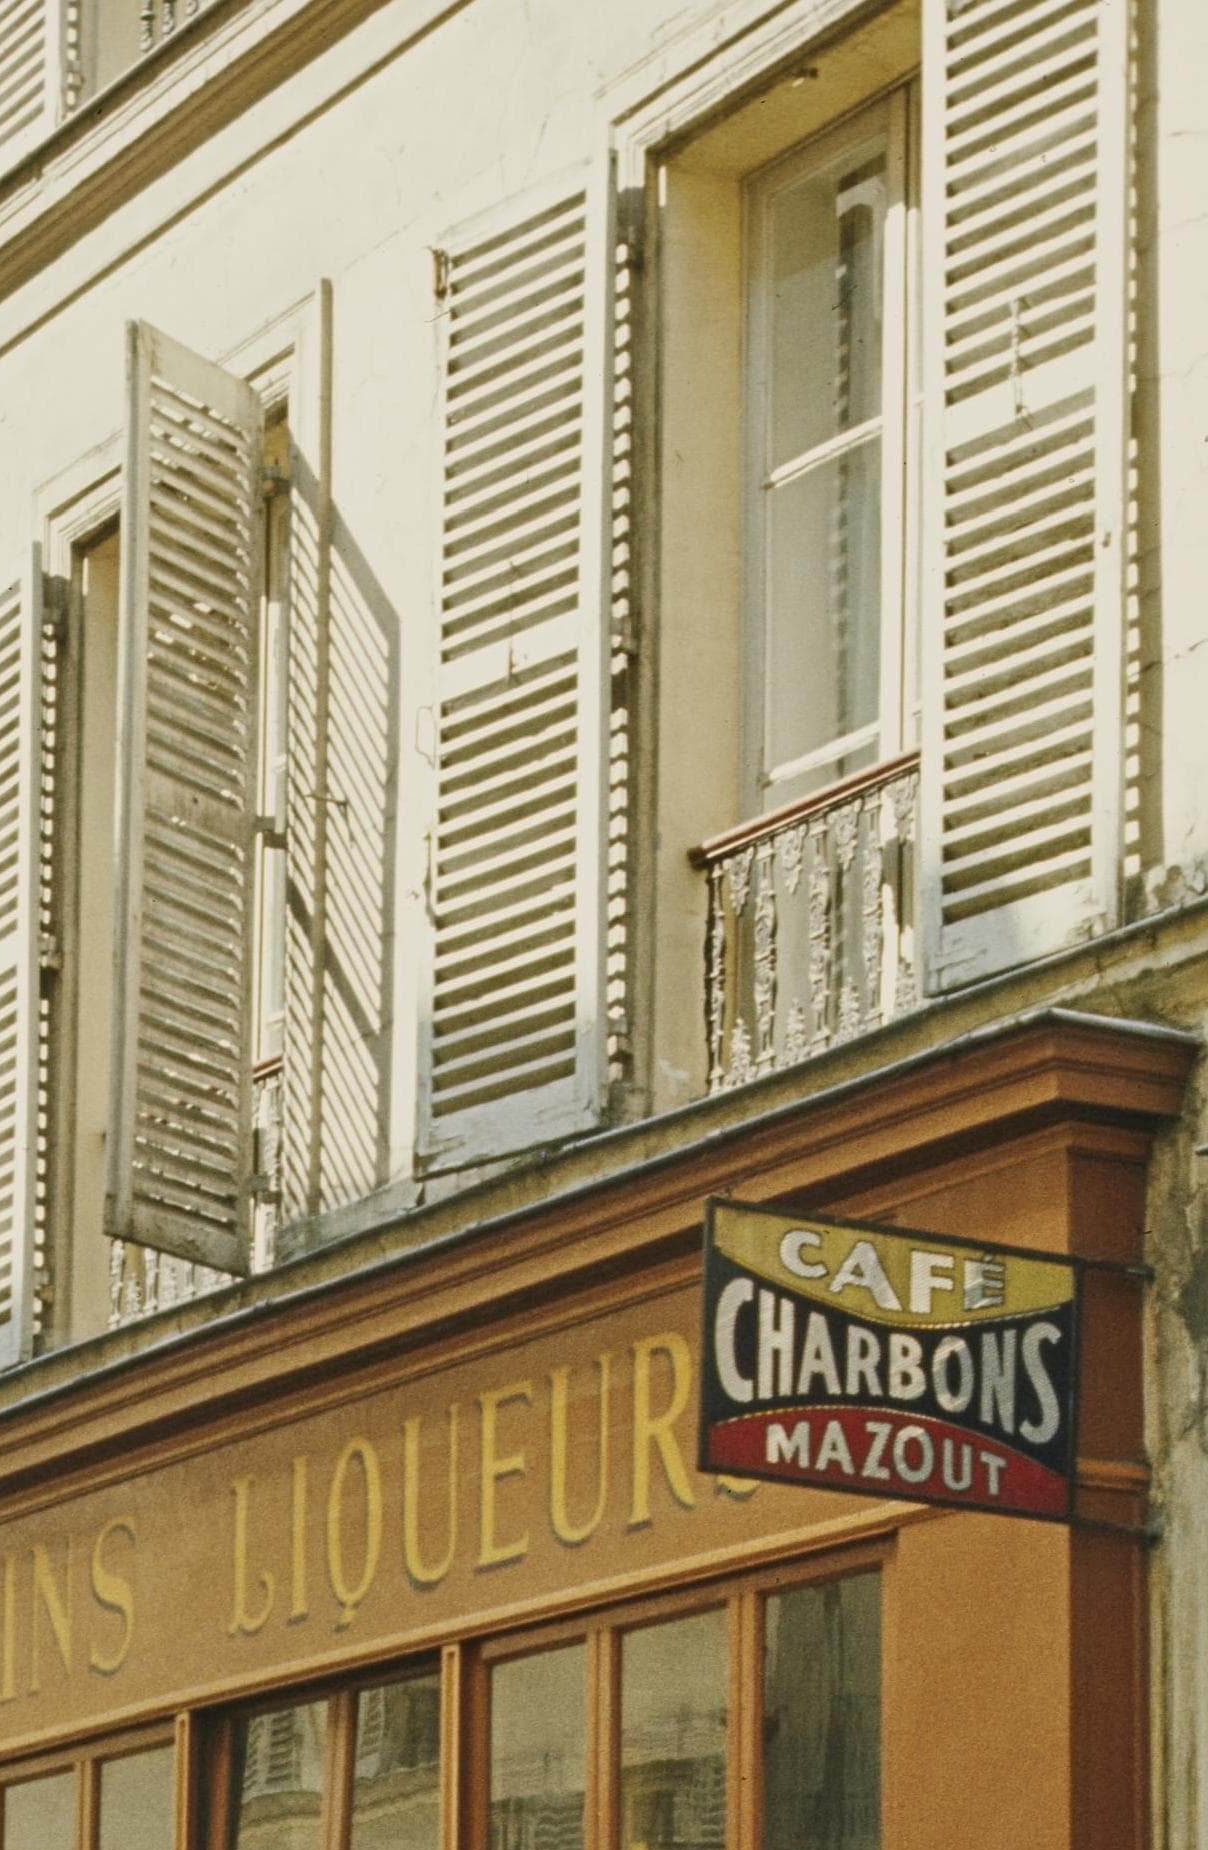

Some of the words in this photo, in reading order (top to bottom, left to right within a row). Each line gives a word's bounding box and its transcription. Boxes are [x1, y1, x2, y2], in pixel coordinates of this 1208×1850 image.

[714, 1276, 1063, 1444] CHARBONS
[226, 1331, 760, 1635] LIQUEUR
[765, 1420, 1008, 1496] MAZOUT
